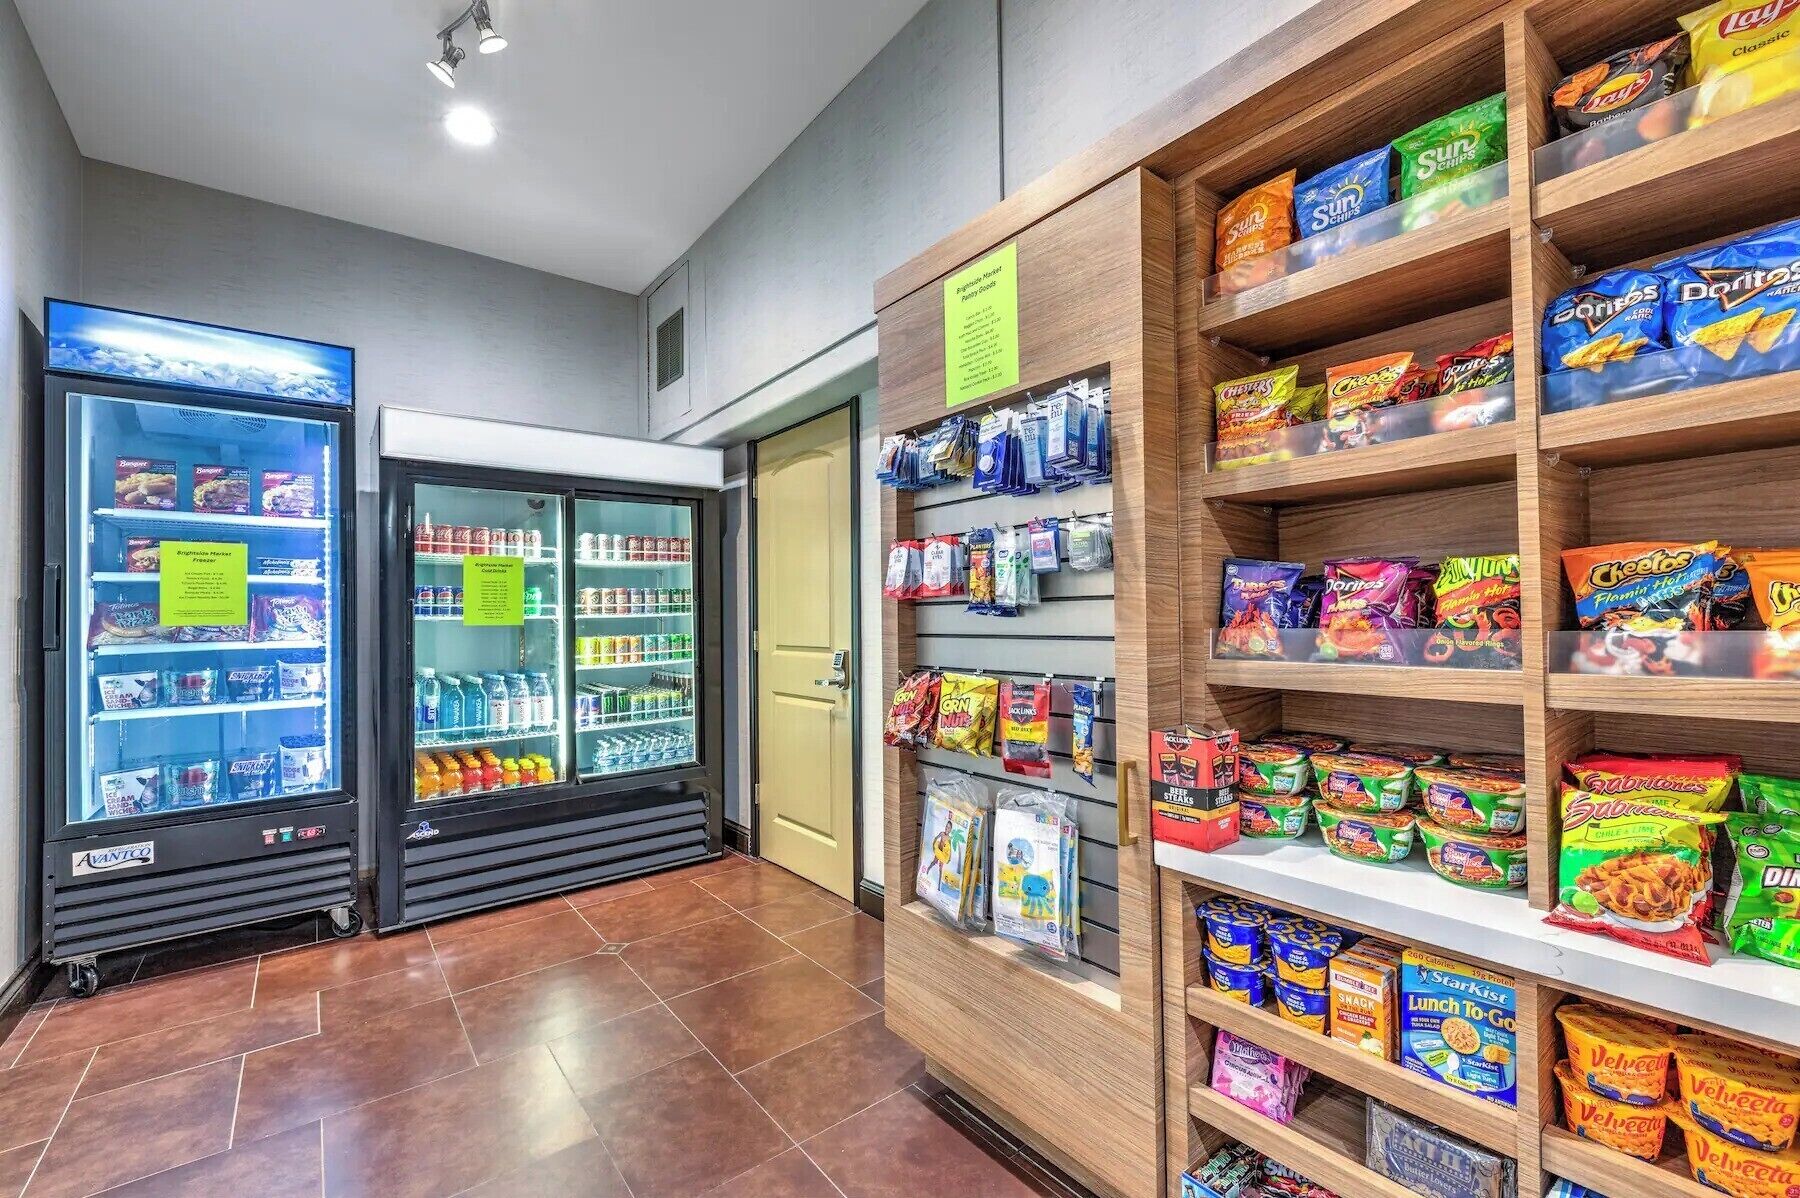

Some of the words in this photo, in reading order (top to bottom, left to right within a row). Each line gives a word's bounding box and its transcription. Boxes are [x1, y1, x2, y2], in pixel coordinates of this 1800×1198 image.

[1732, 30, 1790, 57] Classic
[1417, 138, 1480, 180] Sun
[1436, 149, 1475, 171] CHIPS
[1312, 192, 1363, 231] Sun
[956, 277, 982, 295] Brightside
[982, 265, 1002, 280] Market
[978, 280, 997, 294] Goods
[1554, 284, 1660, 325] Doritos
[1590, 550, 1694, 589] Cheetos
[1324, 579, 1386, 596] Doritos
[1653, 572, 1685, 590] Hot
[940, 693, 970, 715] CORN
[1163, 792, 1194, 805] STEAKS
[1169, 786, 1188, 796] BEEF
[1650, 799, 1670, 808] IME
[406, 828, 440, 840] ASCEND
[77, 847, 151, 868] AVANTCO
[1407, 950, 1423, 960] 260
[1425, 956, 1456, 970] Calories
[1431, 971, 1509, 1005] StarKist
[1337, 992, 1376, 1011] SNACK
[1408, 994, 1460, 1015] Lunch
[1467, 1058, 1499, 1072] StarKist
[1591, 1045, 1668, 1072] Velveeta
[1691, 1073, 1788, 1114] Velveeta
[1580, 1099, 1661, 1133] Velveeta
[1696, 1136, 1793, 1184] Velveeta
[1404, 1163, 1430, 1182] Butter
[1430, 1173, 1457, 1195] Lovers
